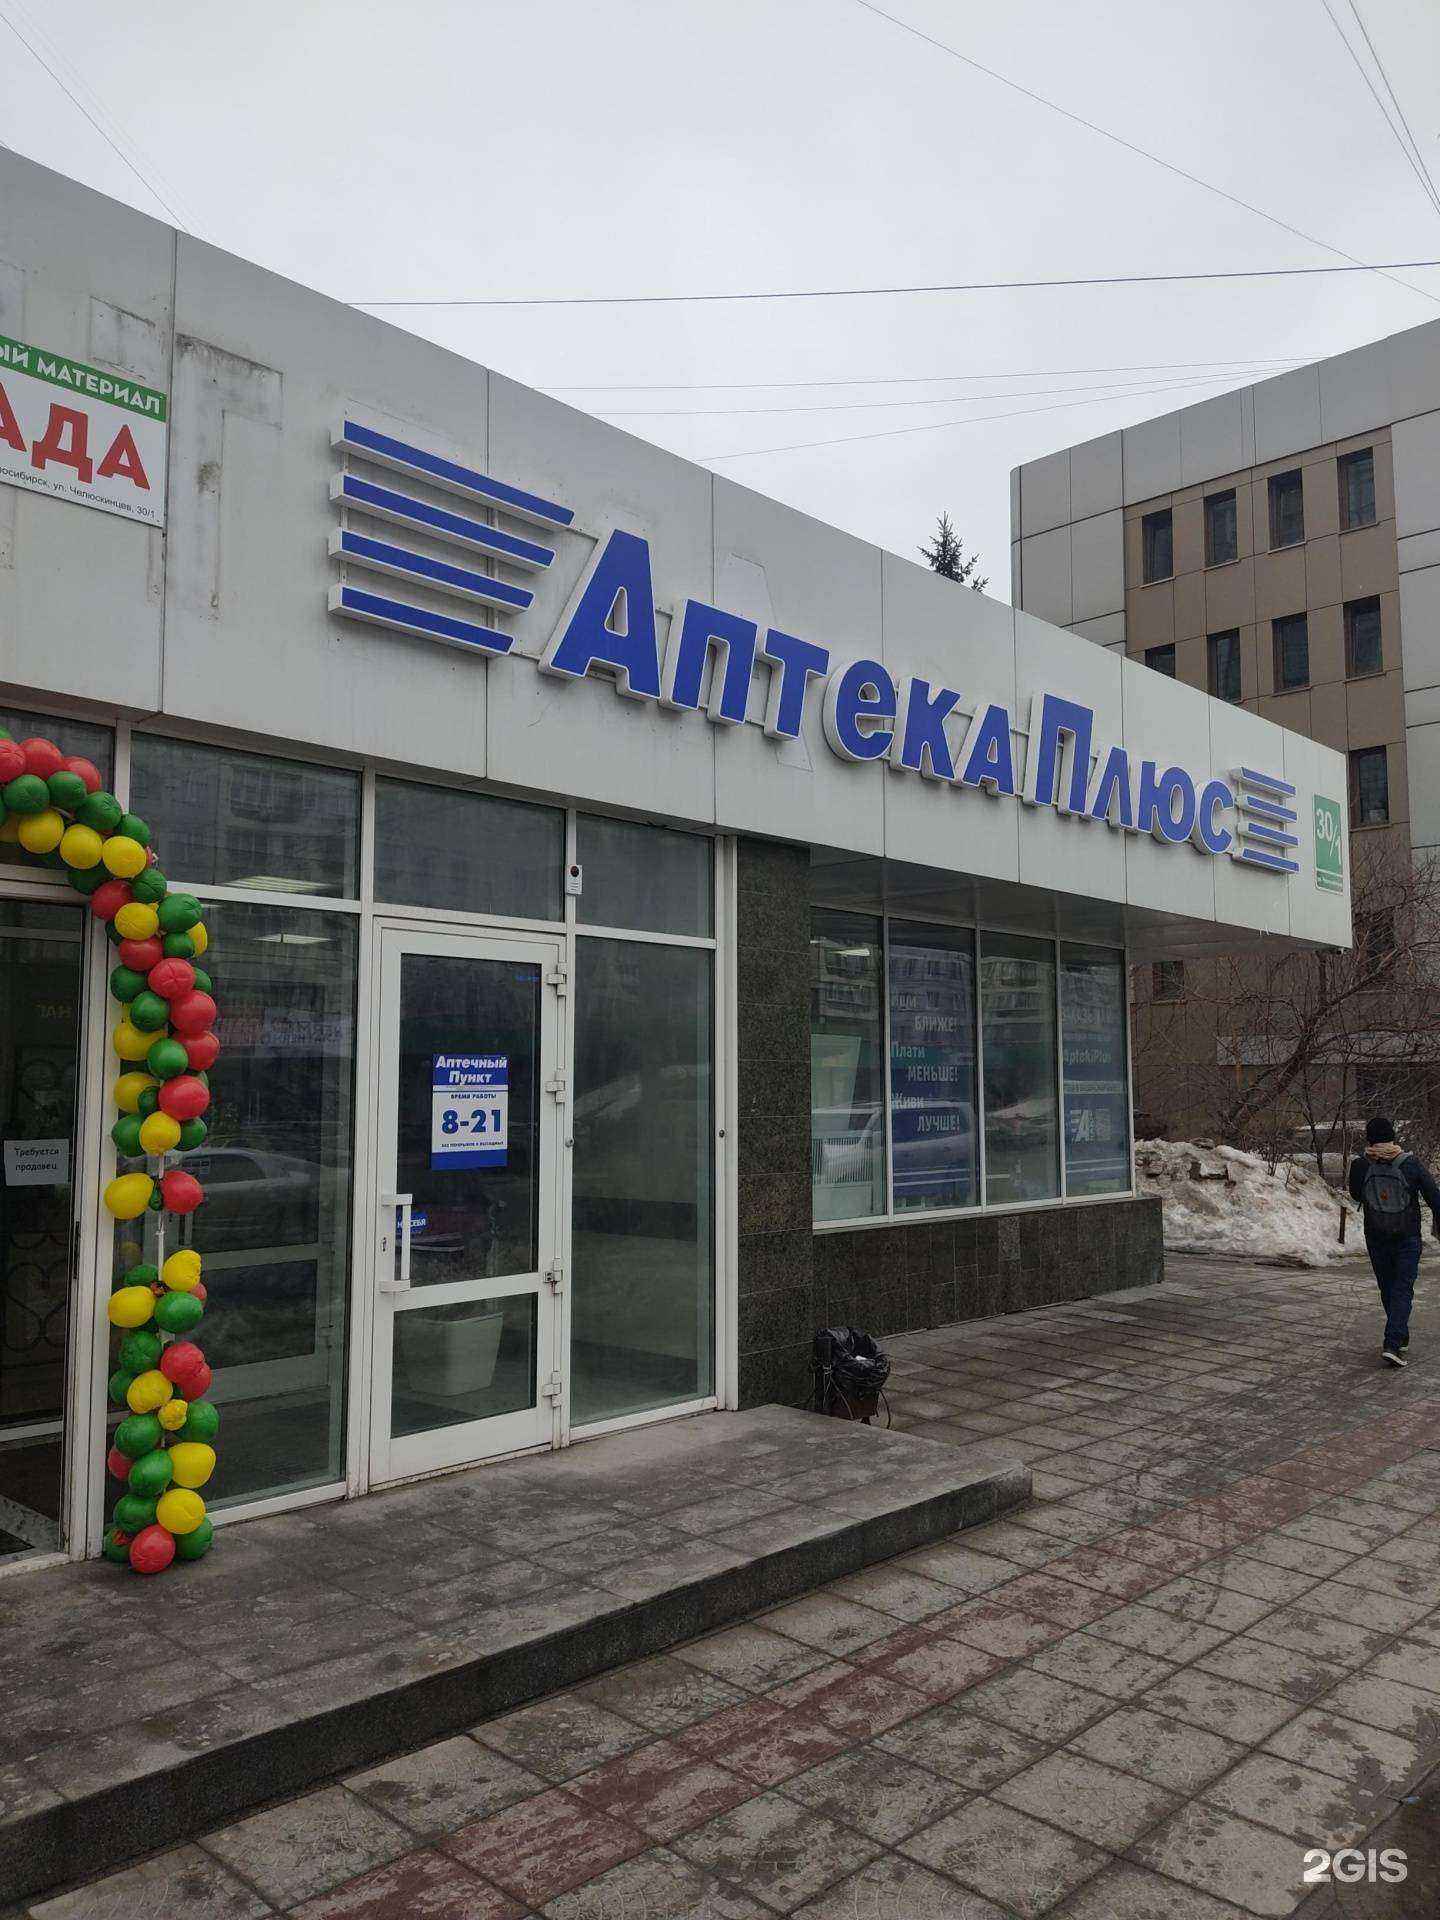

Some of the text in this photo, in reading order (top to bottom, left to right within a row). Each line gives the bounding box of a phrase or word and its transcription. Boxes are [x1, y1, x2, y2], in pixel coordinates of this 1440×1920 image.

[37, 356, 161, 415] МАТЕРИАЛ
[1316, 808, 1342, 865] 30/1
[435, 1055, 507, 1068] Аптечный
[449, 1070, 493, 1085] Пункт
[441, 1109, 502, 1134] 8-21
[916, 1113, 961, 1132] ЛУЧШЕ!
[15, 1146, 59, 1157] Требуется
[15, 1163, 57, 1172] продавец
